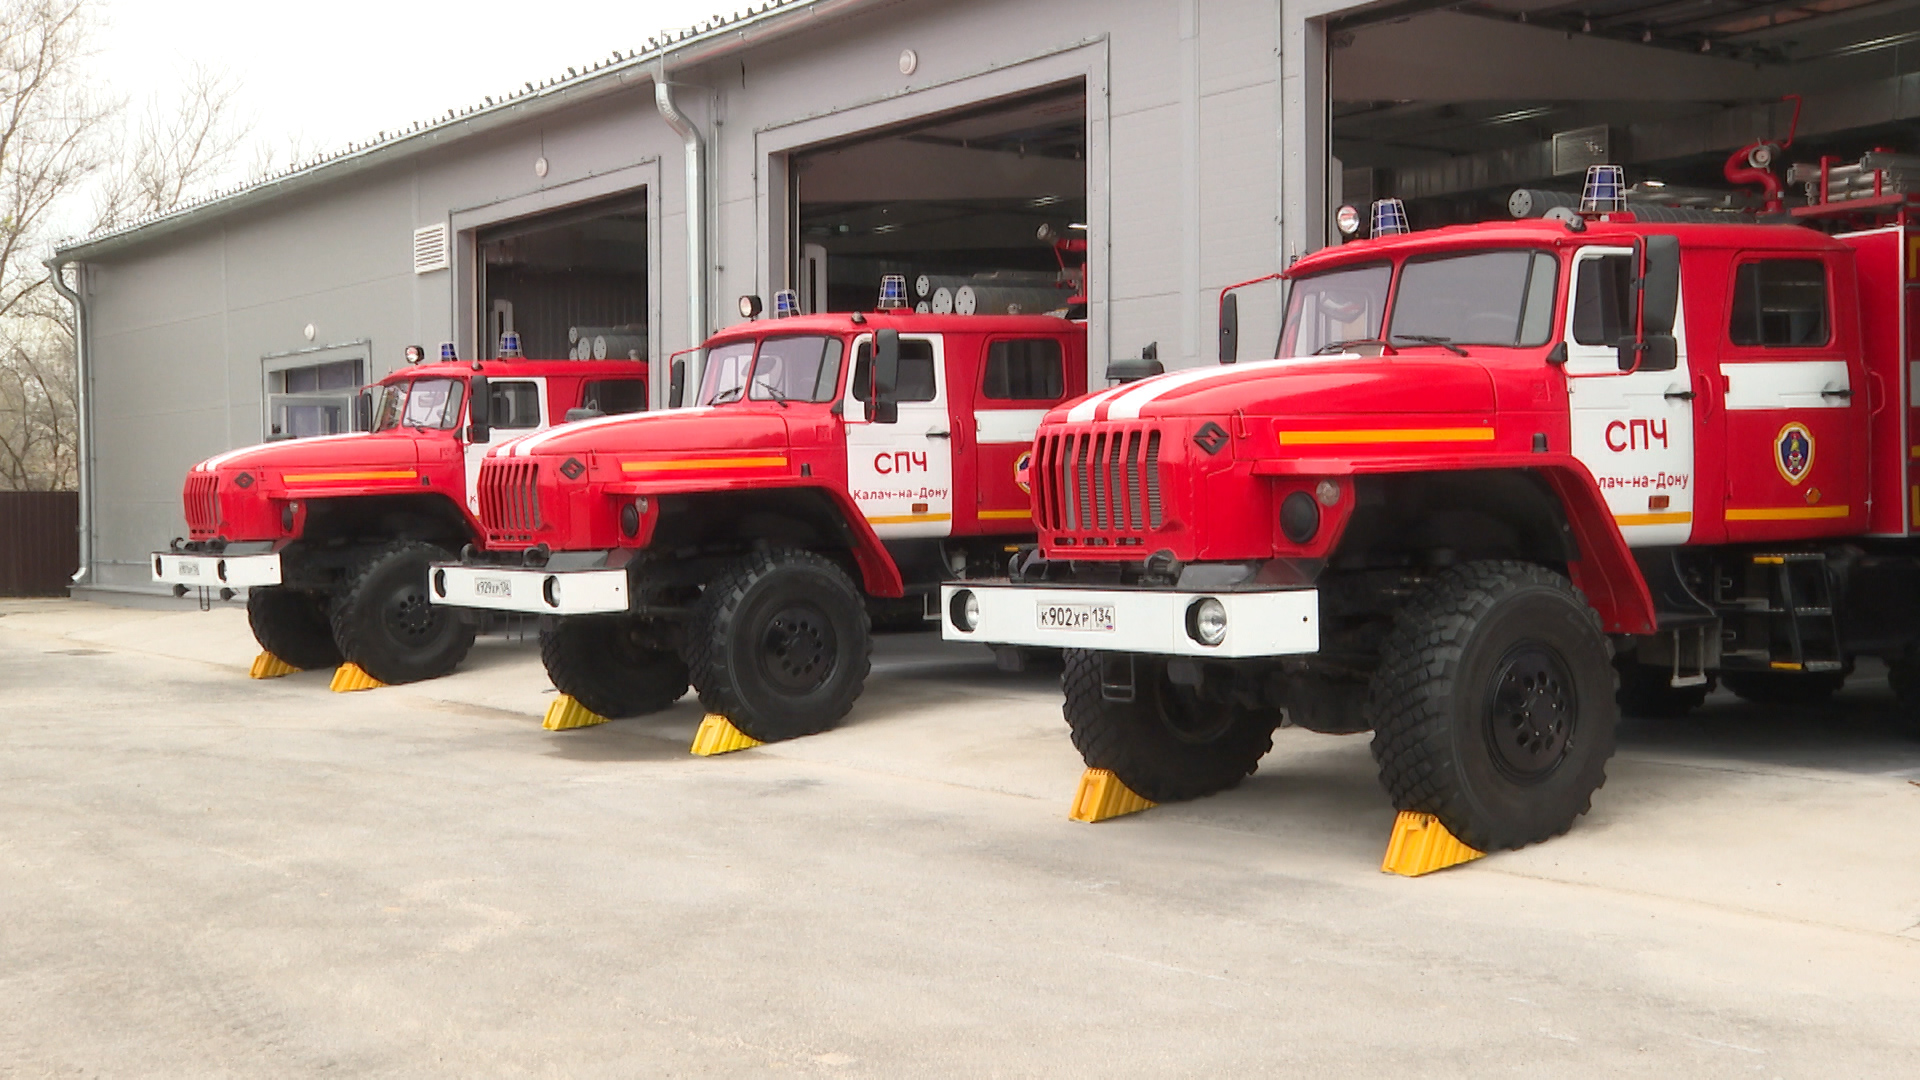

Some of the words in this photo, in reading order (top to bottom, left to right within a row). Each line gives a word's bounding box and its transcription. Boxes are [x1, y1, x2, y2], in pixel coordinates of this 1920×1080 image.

[1604, 417, 1669, 453] СПЧ
[873, 450, 928, 475] СПЧ
[1598, 470, 1690, 490] лач-на-Дону
[852, 486, 949, 501] Калач-на-Дону
